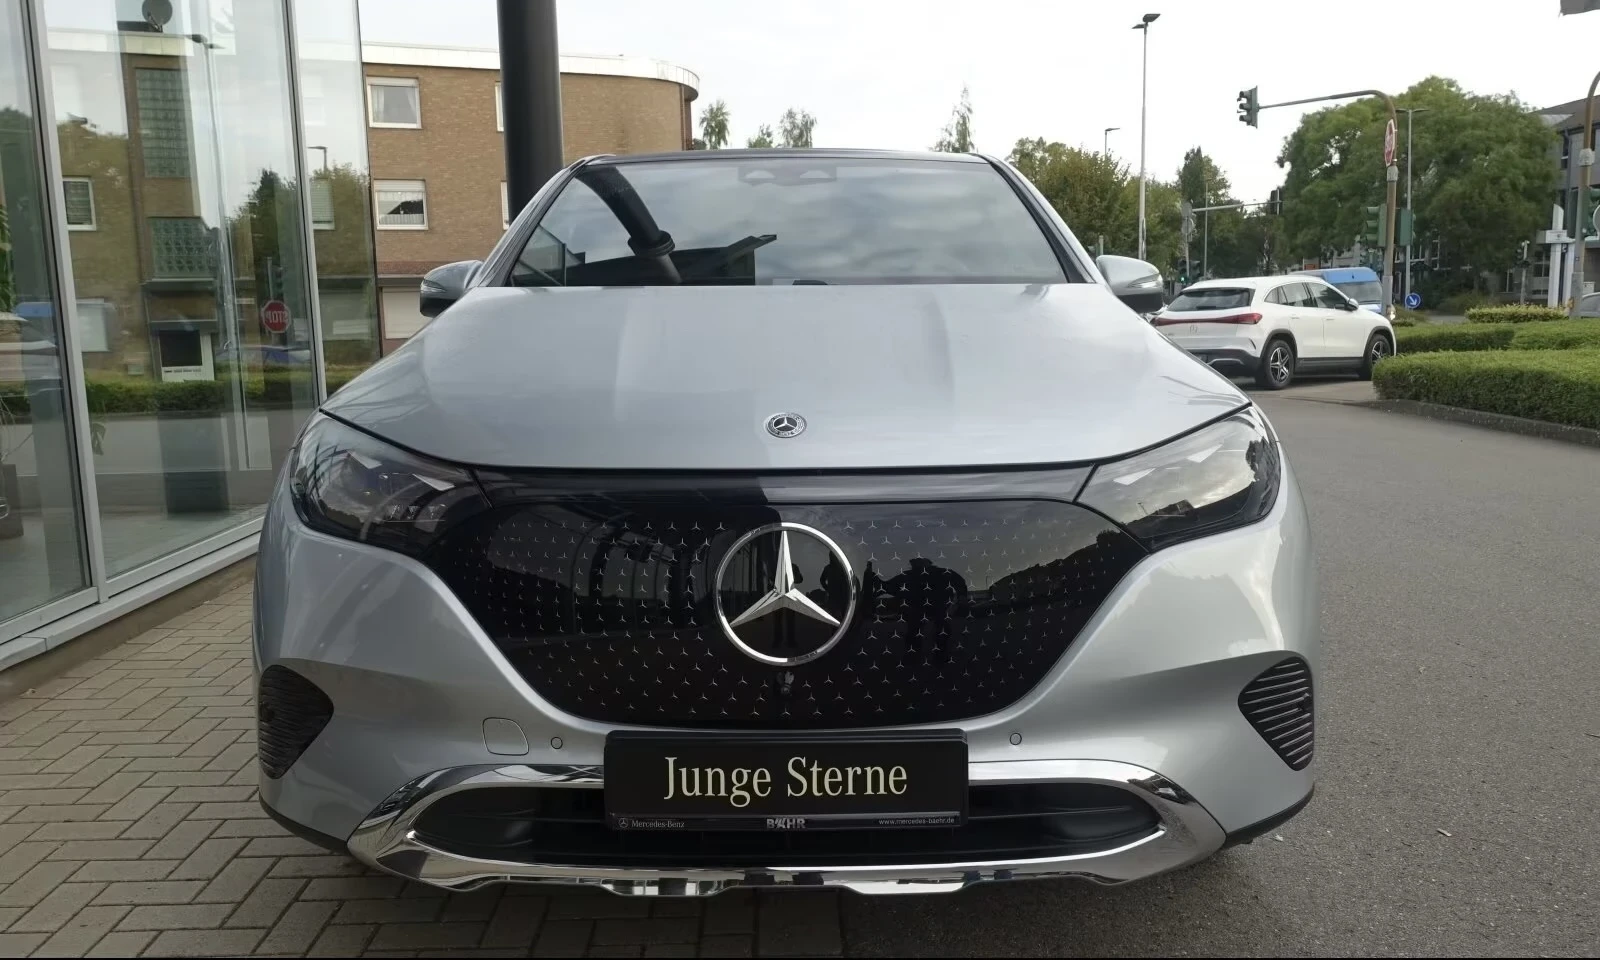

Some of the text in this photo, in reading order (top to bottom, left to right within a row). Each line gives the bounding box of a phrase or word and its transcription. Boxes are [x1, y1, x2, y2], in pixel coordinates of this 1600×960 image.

[663, 756, 908, 808] Junge Sterne
[631, 819, 685, 828] Mercedes-Benz
